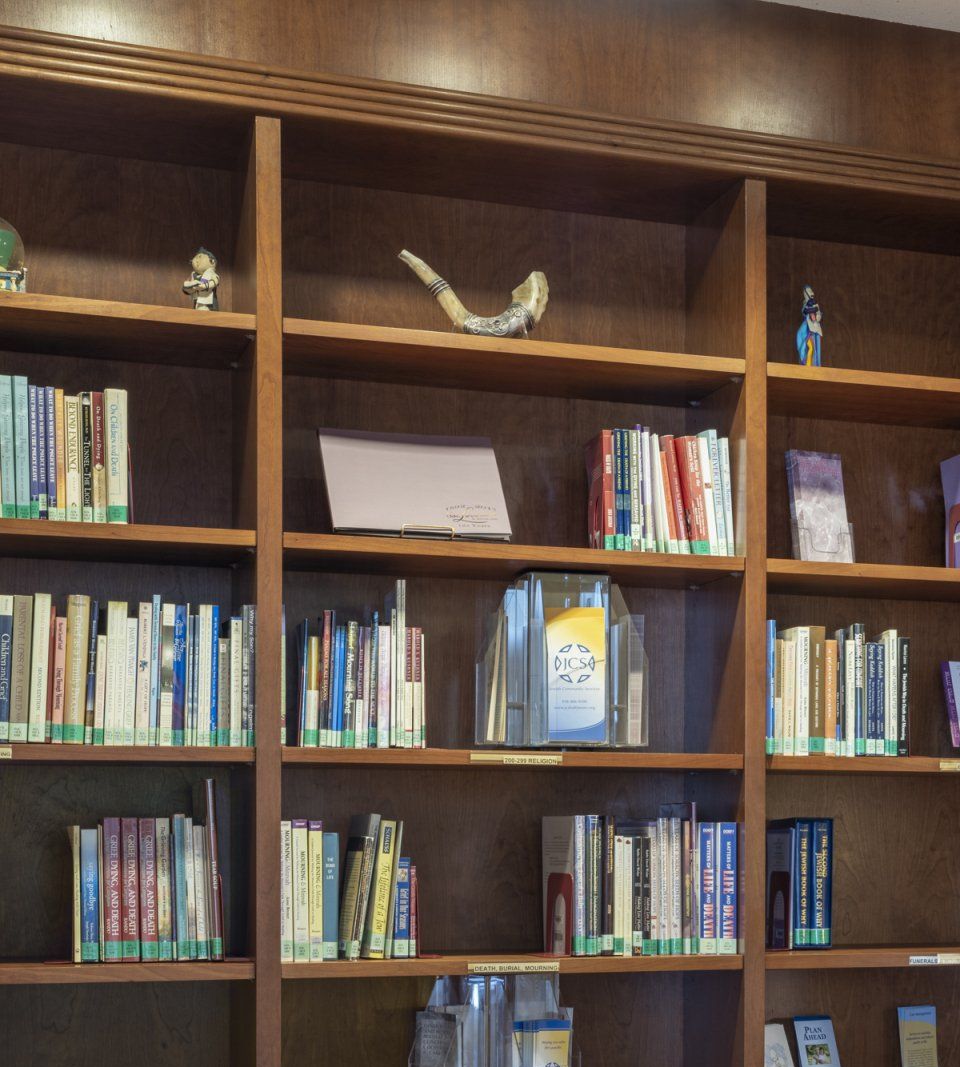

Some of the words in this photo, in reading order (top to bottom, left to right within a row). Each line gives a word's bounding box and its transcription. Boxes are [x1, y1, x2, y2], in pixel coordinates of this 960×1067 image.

[48, 412, 54, 421] DO
[68, 402, 77, 429] BEYOND
[68, 431, 77, 472] ENDURANCE
[83, 441, 91, 467] TUNNEL
[18, 601, 26, 640] PARENTAL
[249, 626, 254, 635] my
[1, 633, 10, 666] Children
[17, 643, 26, 662] LOSS
[1, 667, 9, 679] and
[17, 665, 25, 674] OF
[346, 653, 355, 691] Mourning
[563, 657, 587, 671] JCS
[0, 681, 9, 700] Grief
[15, 685, 23, 711] CHILD
[344, 693, 354, 714] Song
[159, 835, 167, 858] Grieving
[383, 828, 391, 853] SCHAUSS
[87, 862, 95, 882] saying
[126, 860, 136, 887] DYING,
[145, 860, 154, 887] DYING,
[382, 864, 390, 876] The
[815, 853, 823, 877] JEWISH
[378, 877, 389, 903] Lifetime
[703, 869, 714, 893] LIFE
[723, 870, 734, 894] LIFE
[87, 883, 96, 911] goodbye
[128, 889, 136, 908] AND
[146, 889, 154, 908] AND
[400, 888, 409, 898] Grief
[801, 898, 807, 908] OF
[816, 901, 823, 910] OF
[129, 909, 137, 935] DEATH
[147, 909, 155, 935] DEATH
[376, 919, 385, 932] Jew
[399, 913, 408, 930] Seasons
[703, 903, 714, 938] DEATH
[722, 904, 734, 939] DEATH
[803, 1033, 827, 1041] AHEAD
[804, 1026, 822, 1034] PLAN
